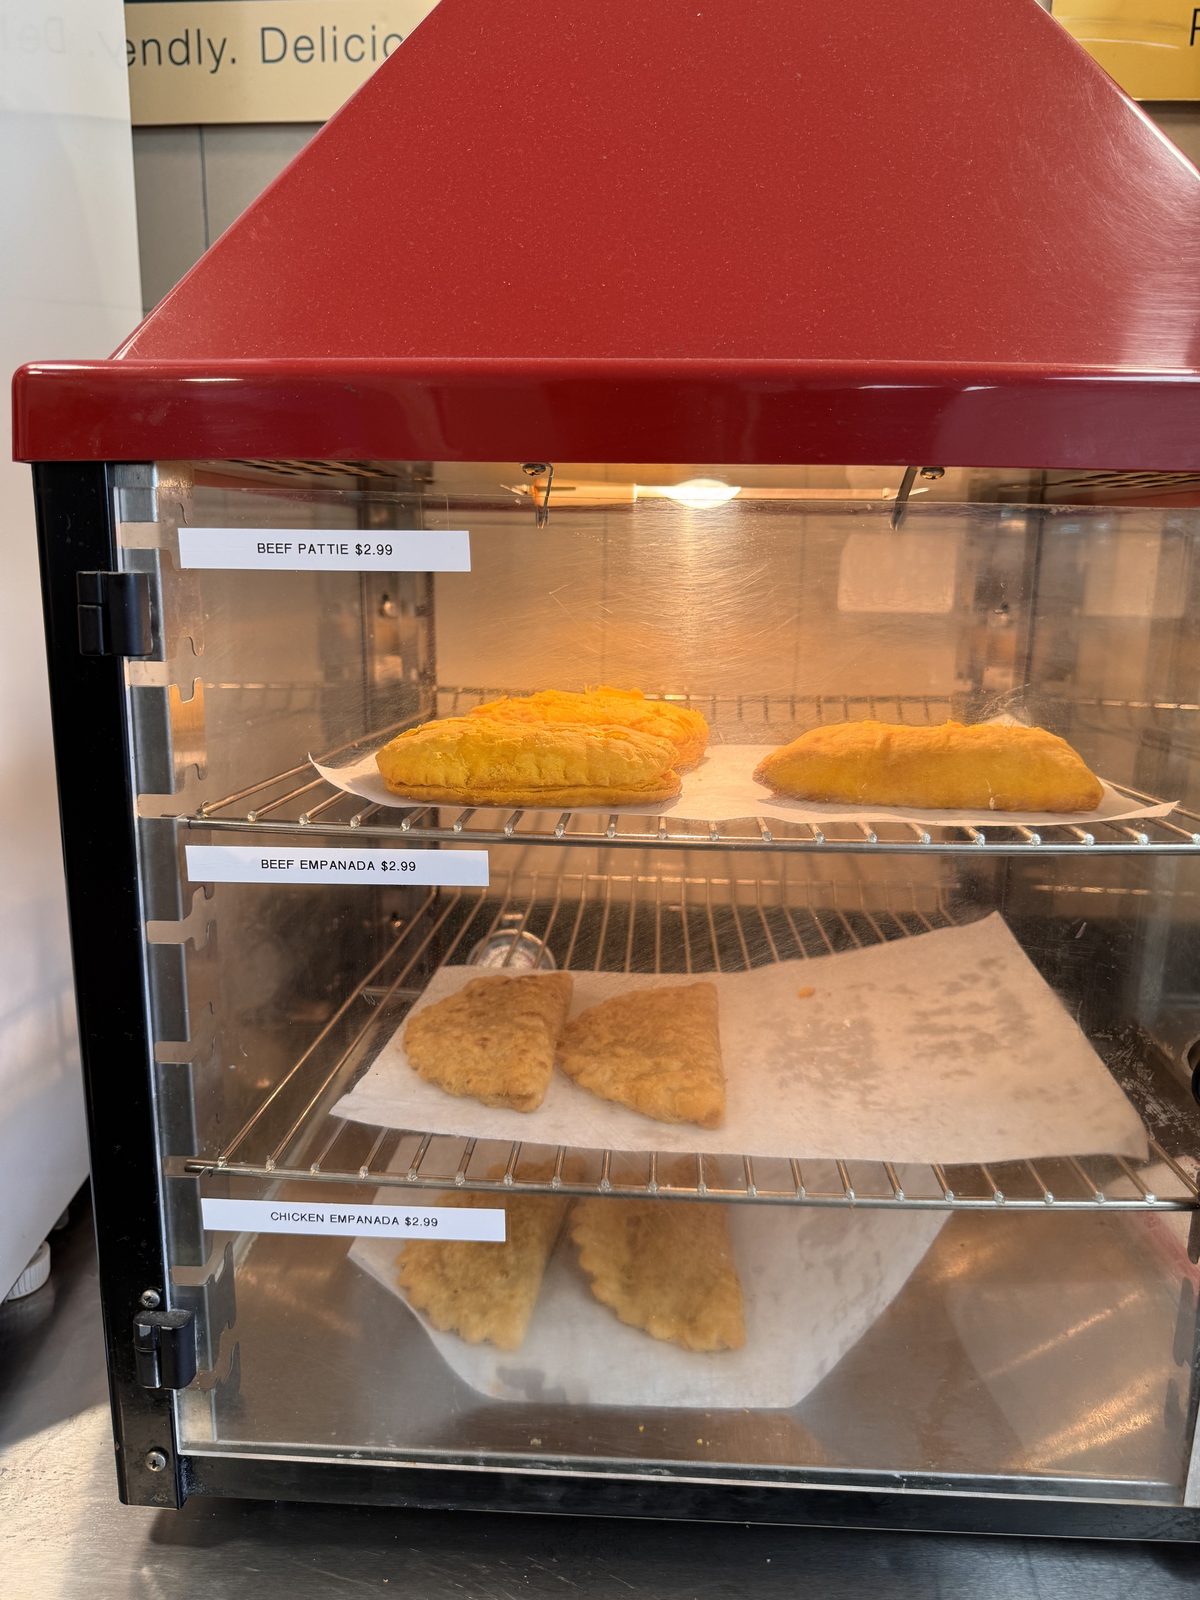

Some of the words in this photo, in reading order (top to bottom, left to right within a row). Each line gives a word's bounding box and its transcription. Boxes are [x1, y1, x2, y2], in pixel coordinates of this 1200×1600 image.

[257, 542, 293, 555] BEEF
[298, 543, 349, 556] PATTIE
[355, 543, 393, 557] $2.99
[260, 858, 295, 870] BEEF
[300, 859, 376, 872] EMPANADA
[380, 860, 417, 873] $2.99
[270, 1211, 325, 1223] CHICKEN
[329, 1213, 400, 1226] EMPANADA
[404, 1215, 439, 1227] $2.99
